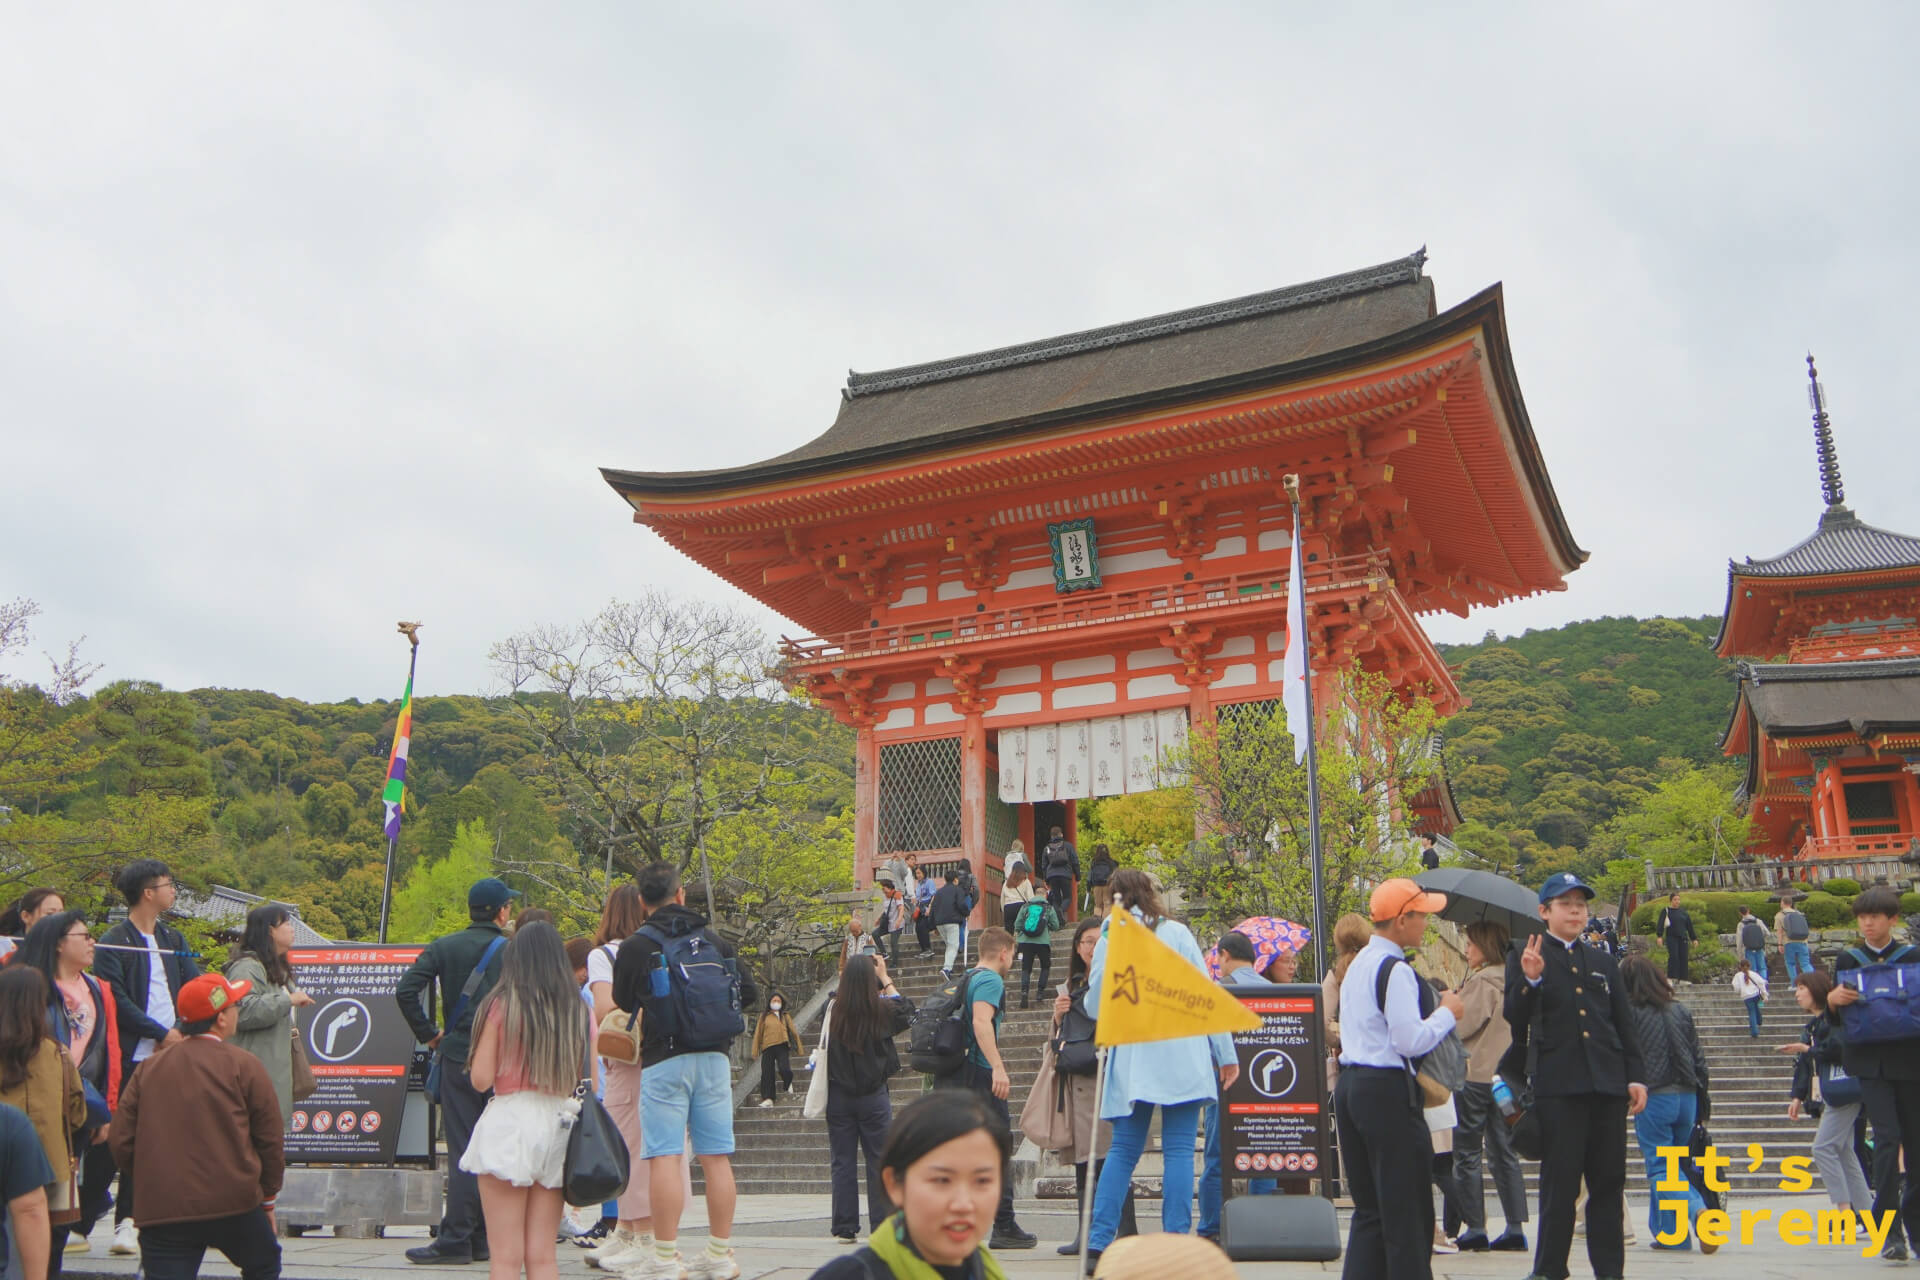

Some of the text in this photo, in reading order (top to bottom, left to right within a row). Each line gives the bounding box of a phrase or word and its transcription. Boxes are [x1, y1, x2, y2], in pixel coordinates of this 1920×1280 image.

[325, 951, 386, 961] ご参拝の皆様へ
[1144, 977, 1215, 1011] Starlight
[1261, 1015, 1302, 1024] 水寺は神仏に
[328, 1067, 335, 1075] to
[336, 1066, 360, 1075] visitors
[1243, 1116, 1280, 1125] Kiyomizu-dera
[1280, 1116, 1299, 1125] Temple
[1273, 1124, 1295, 1132] religious
